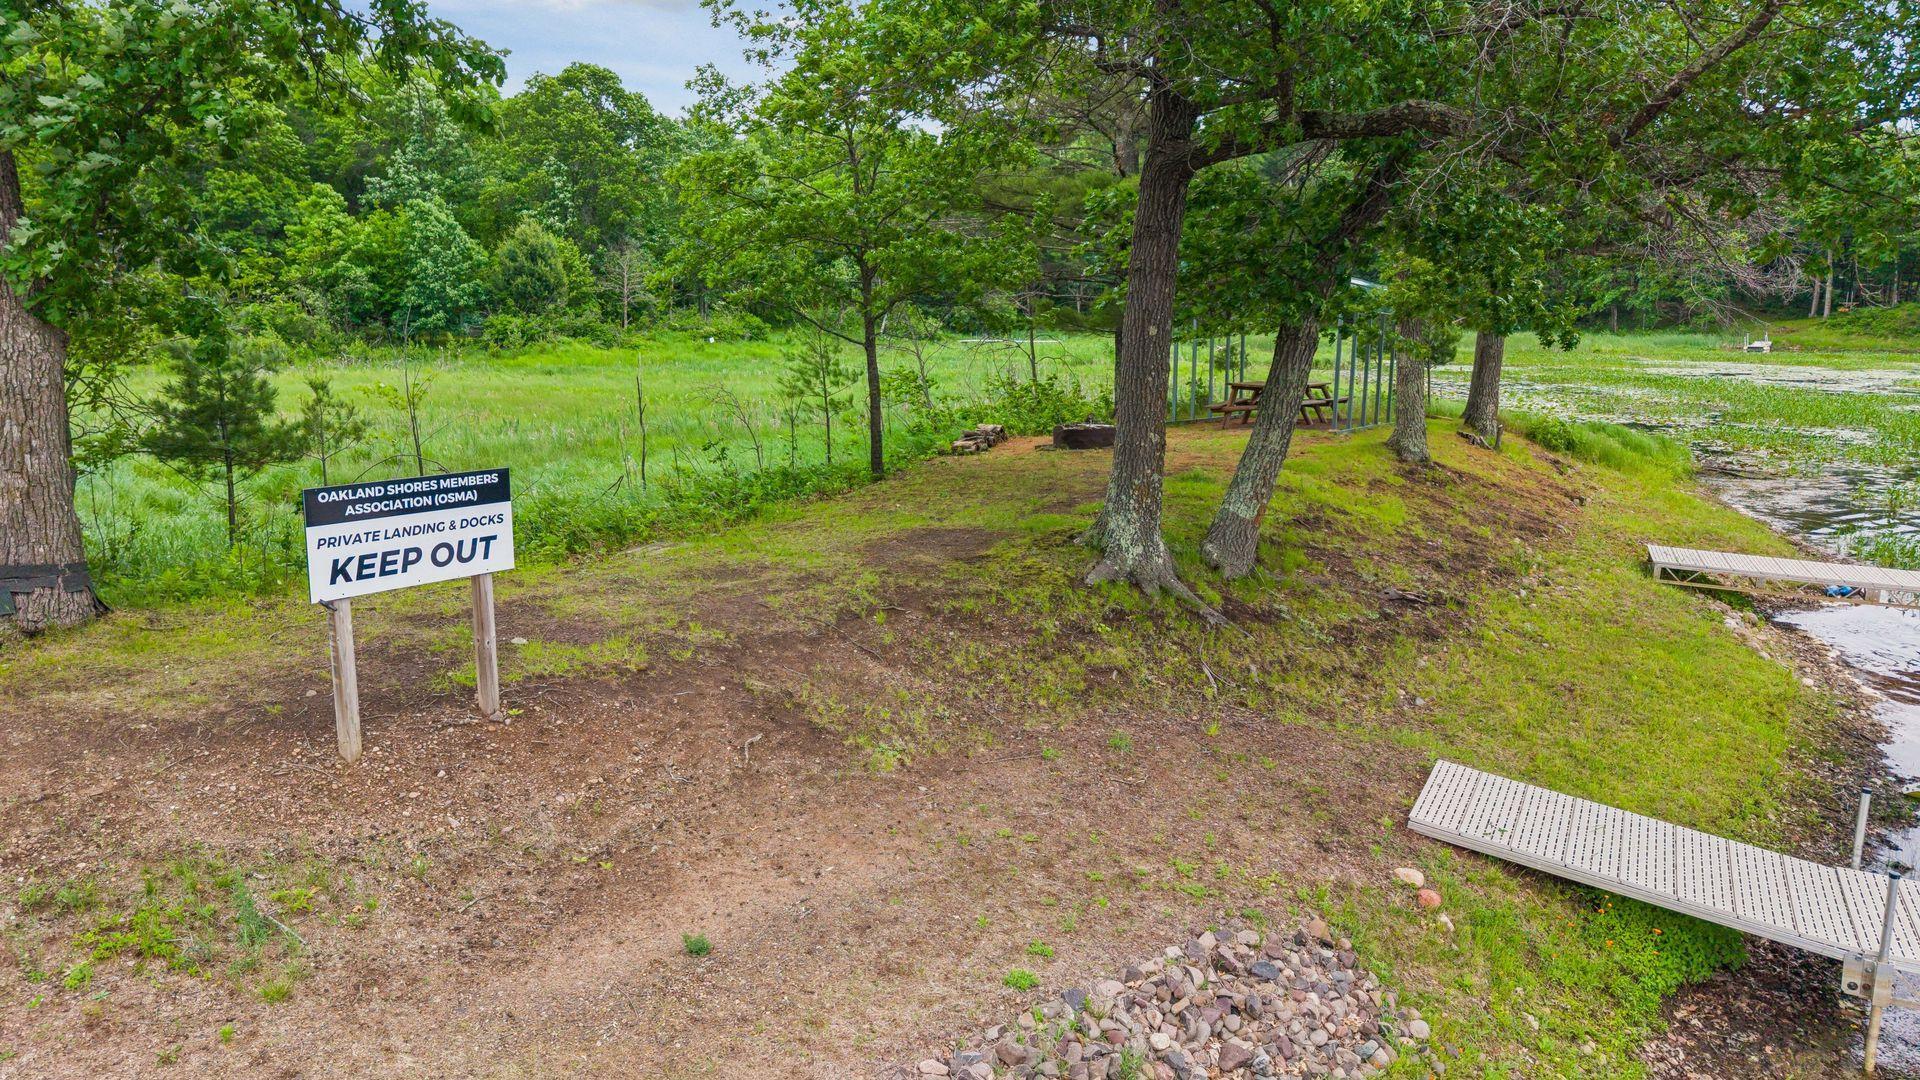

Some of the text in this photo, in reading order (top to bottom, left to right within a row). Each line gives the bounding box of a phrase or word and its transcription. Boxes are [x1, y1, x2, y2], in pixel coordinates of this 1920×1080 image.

[317, 473, 499, 503] OAKLAND SHORES MEMBERS
[345, 490, 478, 516] ASSOCIATION (OSMA)
[317, 513, 504, 550] PRIVATE LANDING & DOCKS
[329, 534, 498, 585] KEEP OUT
